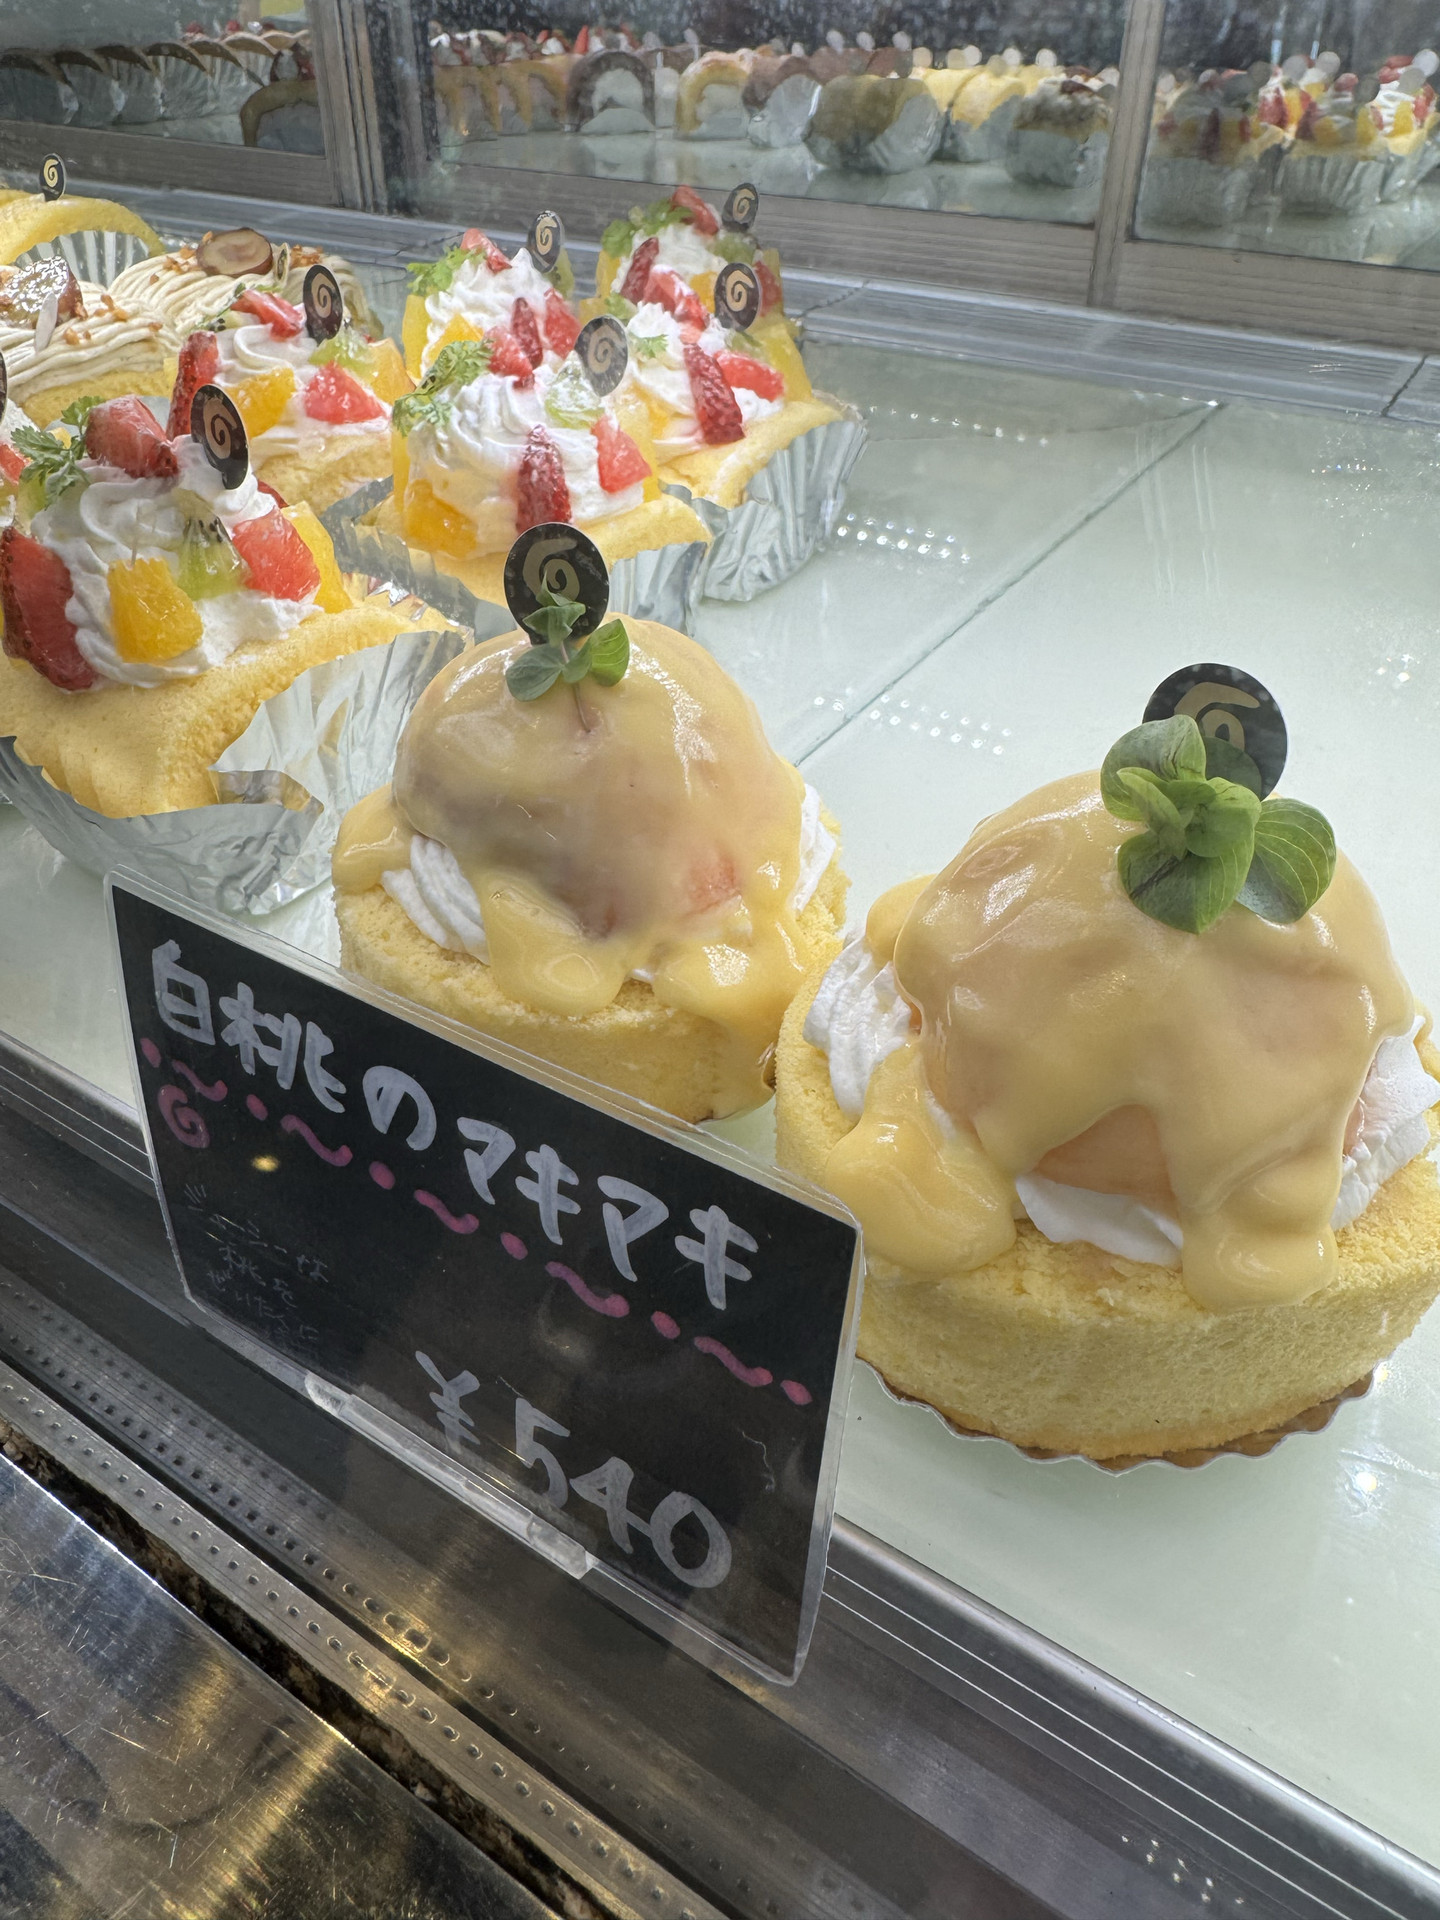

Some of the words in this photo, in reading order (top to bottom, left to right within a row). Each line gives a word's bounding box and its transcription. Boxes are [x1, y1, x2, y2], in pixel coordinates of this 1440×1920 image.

[152, 939, 759, 1311] 白桃のマキマキ
[415, 1350, 733, 1588] ¥540
